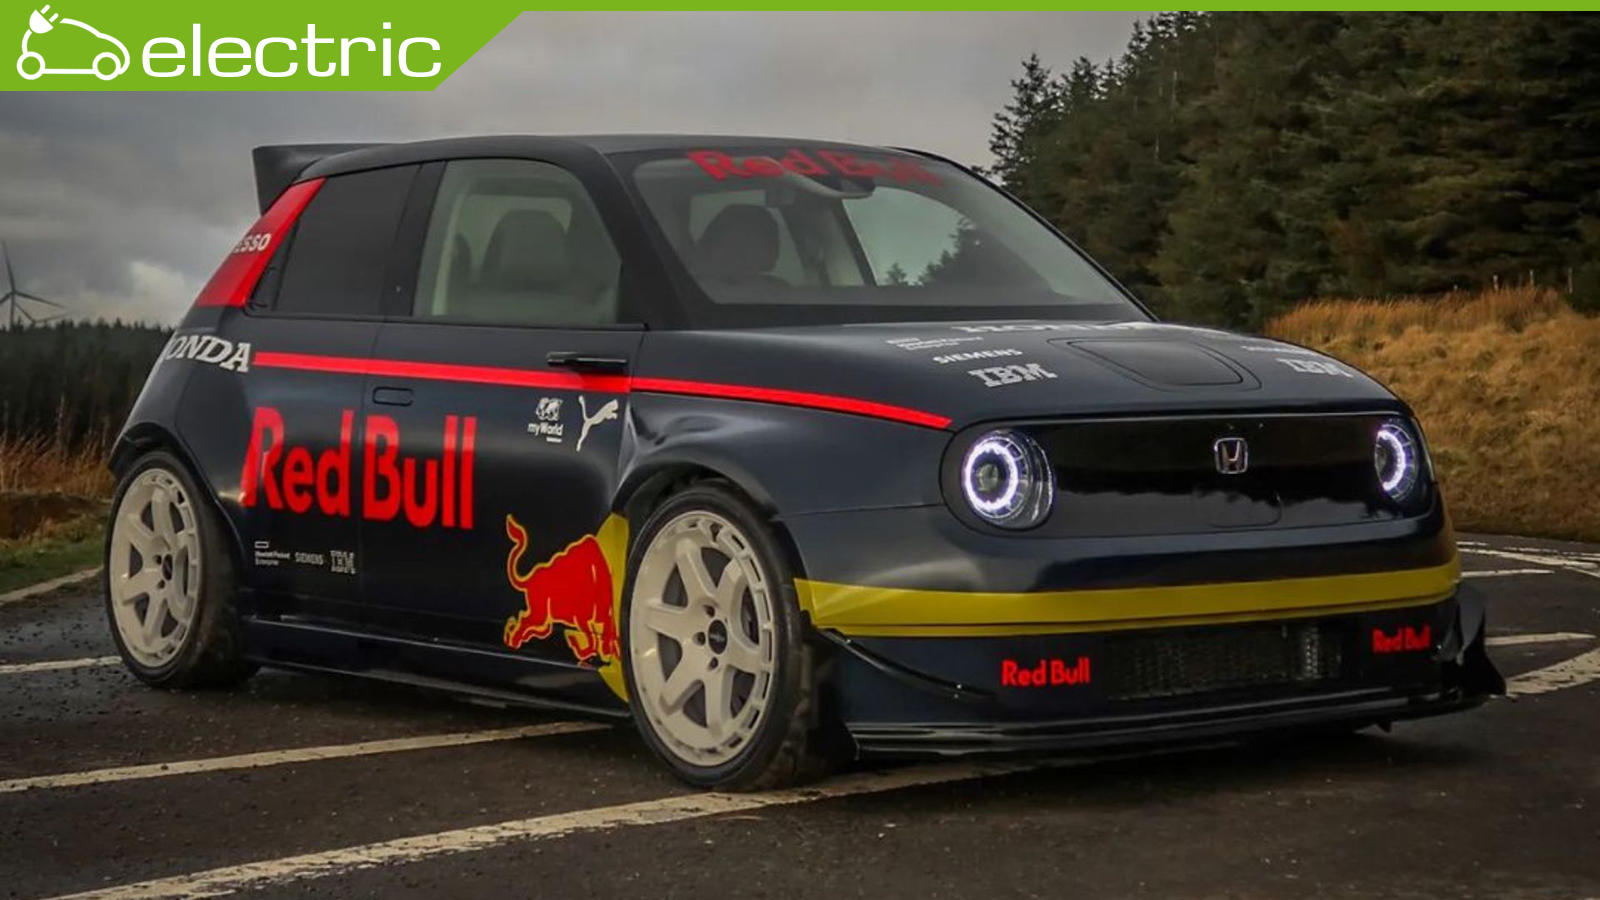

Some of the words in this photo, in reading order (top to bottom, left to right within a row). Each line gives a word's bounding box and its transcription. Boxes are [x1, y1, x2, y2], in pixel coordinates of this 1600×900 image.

[686, 149, 830, 181] Red
[932, 348, 1023, 364] SIEMENS
[967, 363, 1058, 388] IBM
[239, 406, 354, 518] Red
[362, 414, 477, 530] Bull
[1372, 628, 1402, 653] Red
[1001, 659, 1047, 687] Red
[1050, 657, 1091, 686] Bull
